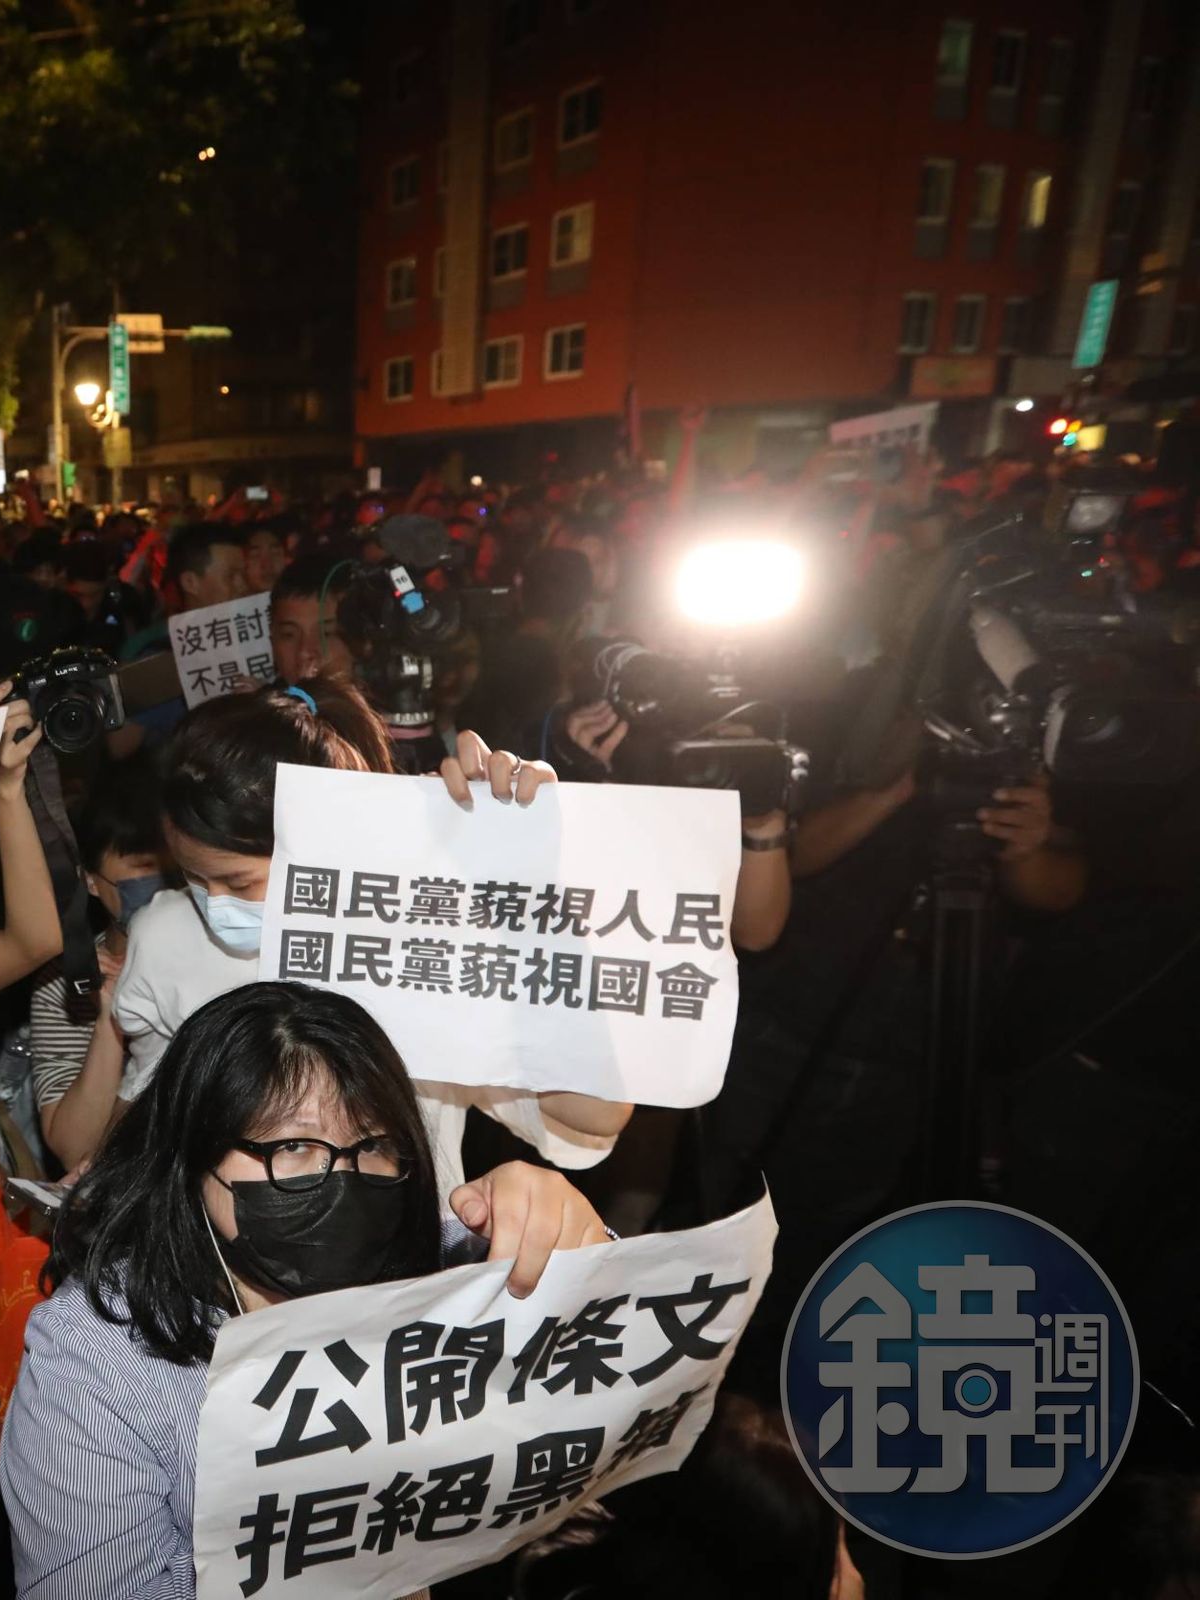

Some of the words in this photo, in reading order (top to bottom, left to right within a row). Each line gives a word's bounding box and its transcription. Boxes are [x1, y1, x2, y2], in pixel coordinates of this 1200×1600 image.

[176, 605, 272, 656] 沒有討
[284, 864, 725, 951] 國民黨藐視人民
[278, 929, 719, 1020] 國民黨藐視國會
[252, 1273, 751, 1467] 公開條文
